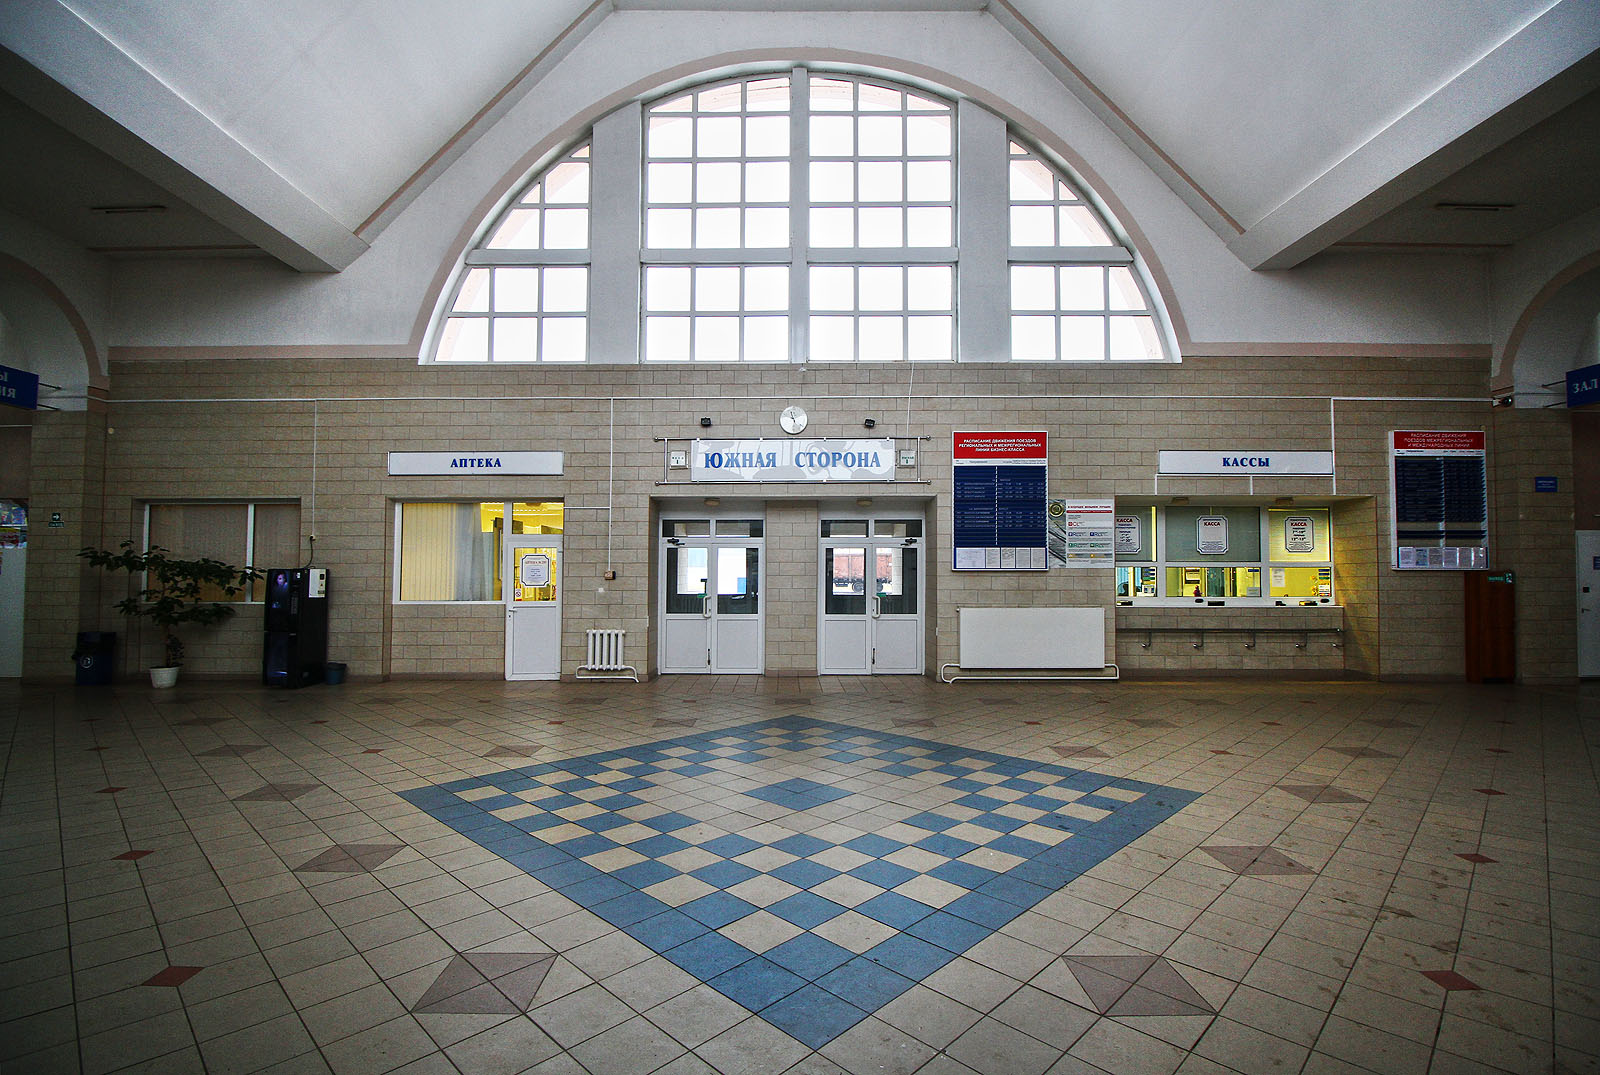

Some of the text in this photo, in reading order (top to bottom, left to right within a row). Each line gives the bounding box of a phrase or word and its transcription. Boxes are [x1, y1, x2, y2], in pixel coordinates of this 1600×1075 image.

[1571, 378, 1598, 394] ЗАЛ
[450, 458, 502, 468] АПТЕКА
[704, 451, 881, 469] ЮЖНАЯ СТОРОНА
[1222, 457, 1270, 467] КАССЫ
